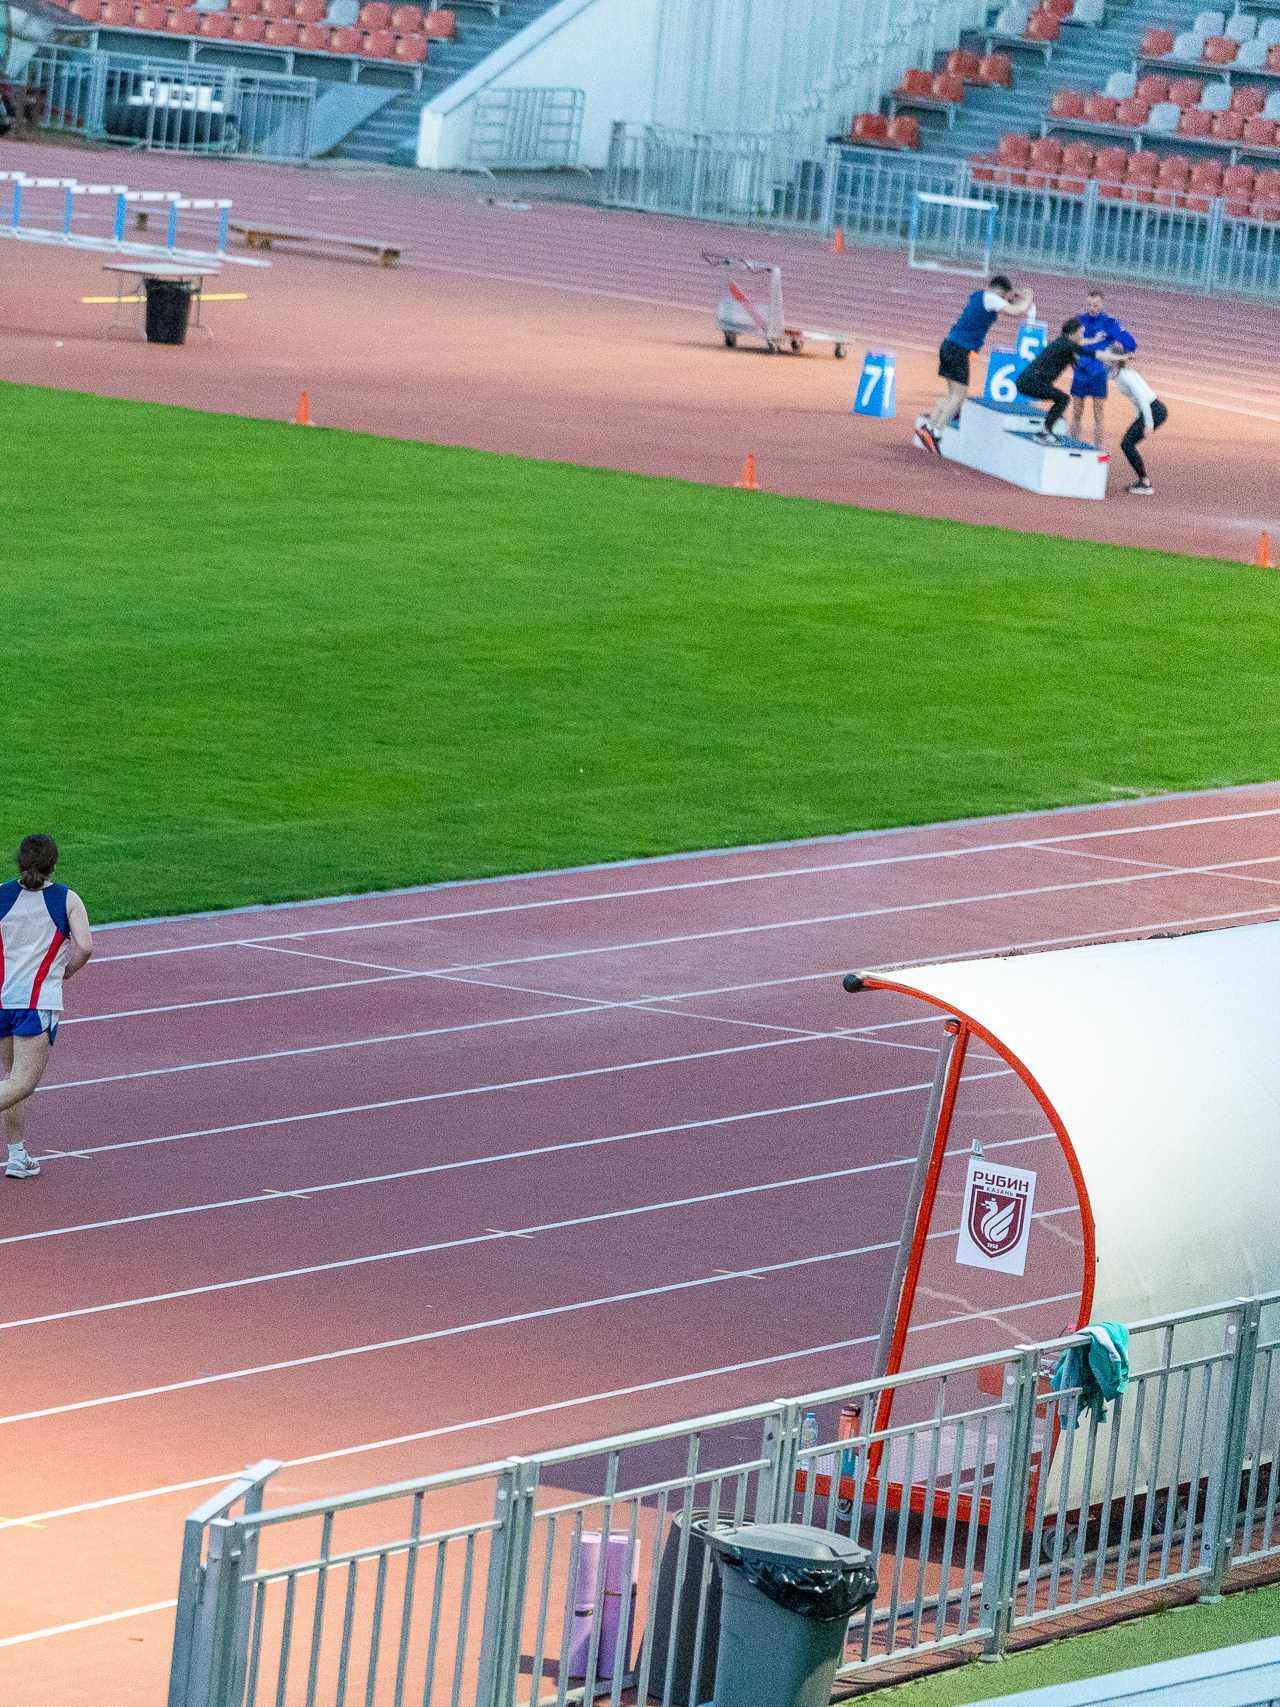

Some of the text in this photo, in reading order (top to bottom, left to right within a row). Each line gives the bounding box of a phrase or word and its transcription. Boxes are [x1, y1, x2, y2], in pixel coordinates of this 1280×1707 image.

[990, 364, 1018, 402] 6
[972, 1170, 1029, 1193] РУБИН
[986, 1186, 1014, 1197] КАЗАНЬ
